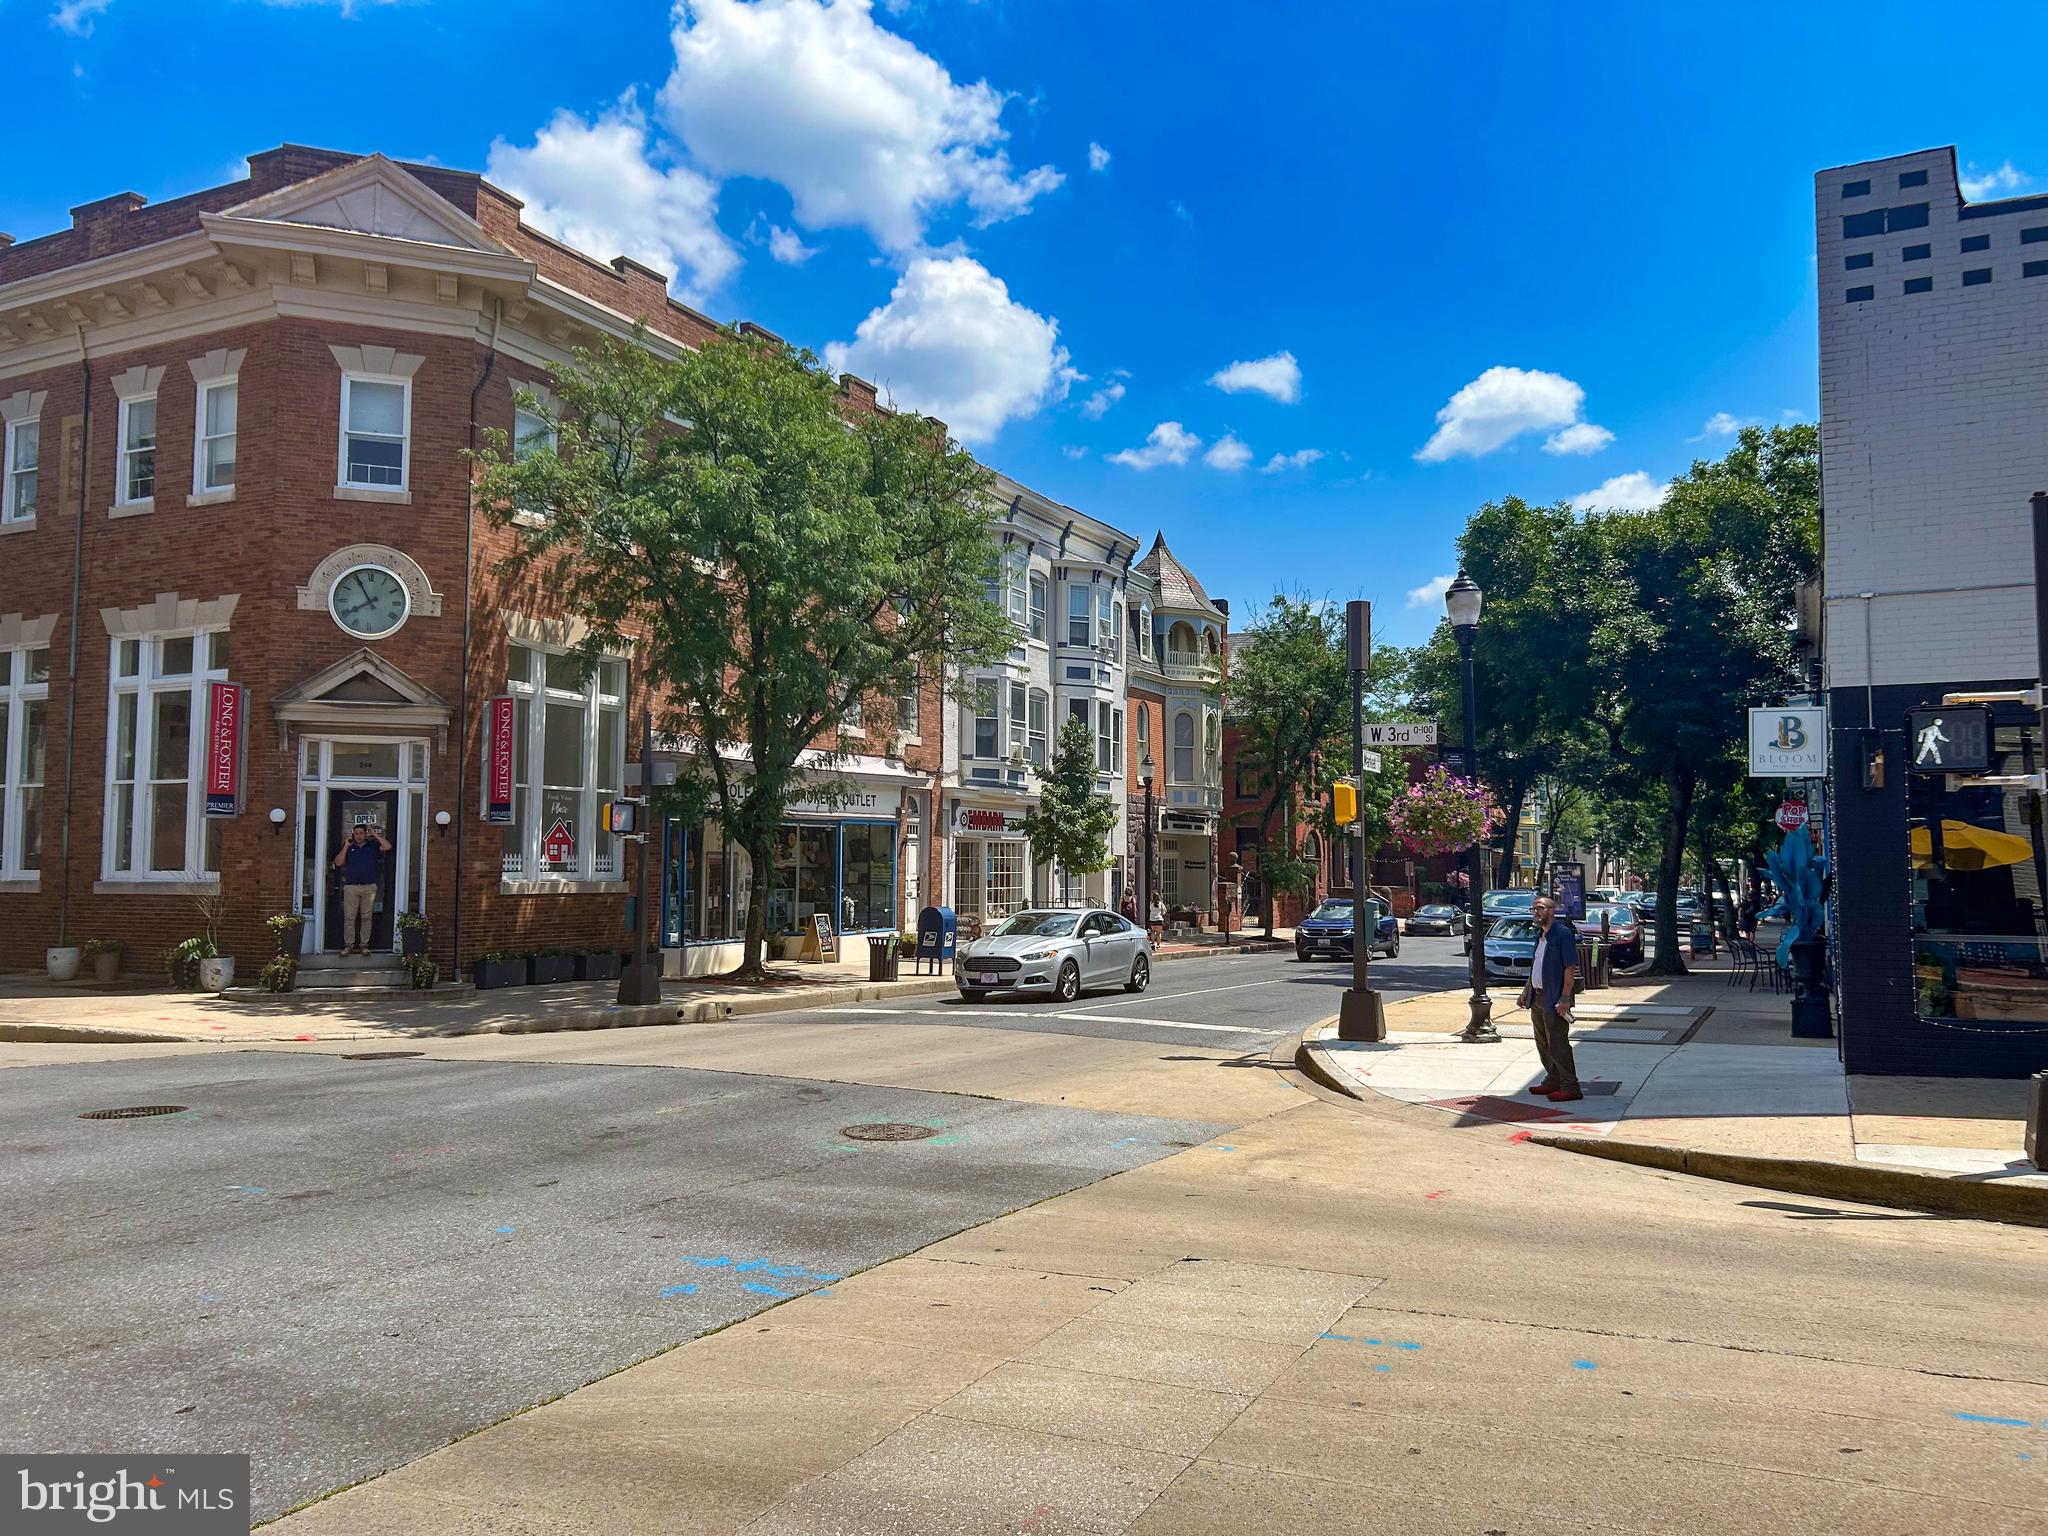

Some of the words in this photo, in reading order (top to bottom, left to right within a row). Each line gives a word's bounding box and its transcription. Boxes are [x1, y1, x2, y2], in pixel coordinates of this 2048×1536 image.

[221, 687, 234, 726] LONG
[501, 702, 511, 738] LONG
[220, 728, 232, 738] &
[1371, 727, 1384, 742] W.
[1388, 727, 1410, 742] 3rd
[1413, 725, 1433, 734] 0-100
[500, 740, 509, 750] &
[218, 739, 232, 790] FOSTER
[1759, 754, 1816, 764] BLOOM
[499, 751, 509, 799] FOSTER
[207, 801, 234, 809] PREMIER
[842, 792, 877, 807] OUTLET
[1782, 803, 1806, 817] POP
[356, 815, 375, 824] OPEN
[967, 809, 1004, 832] EMBARK
